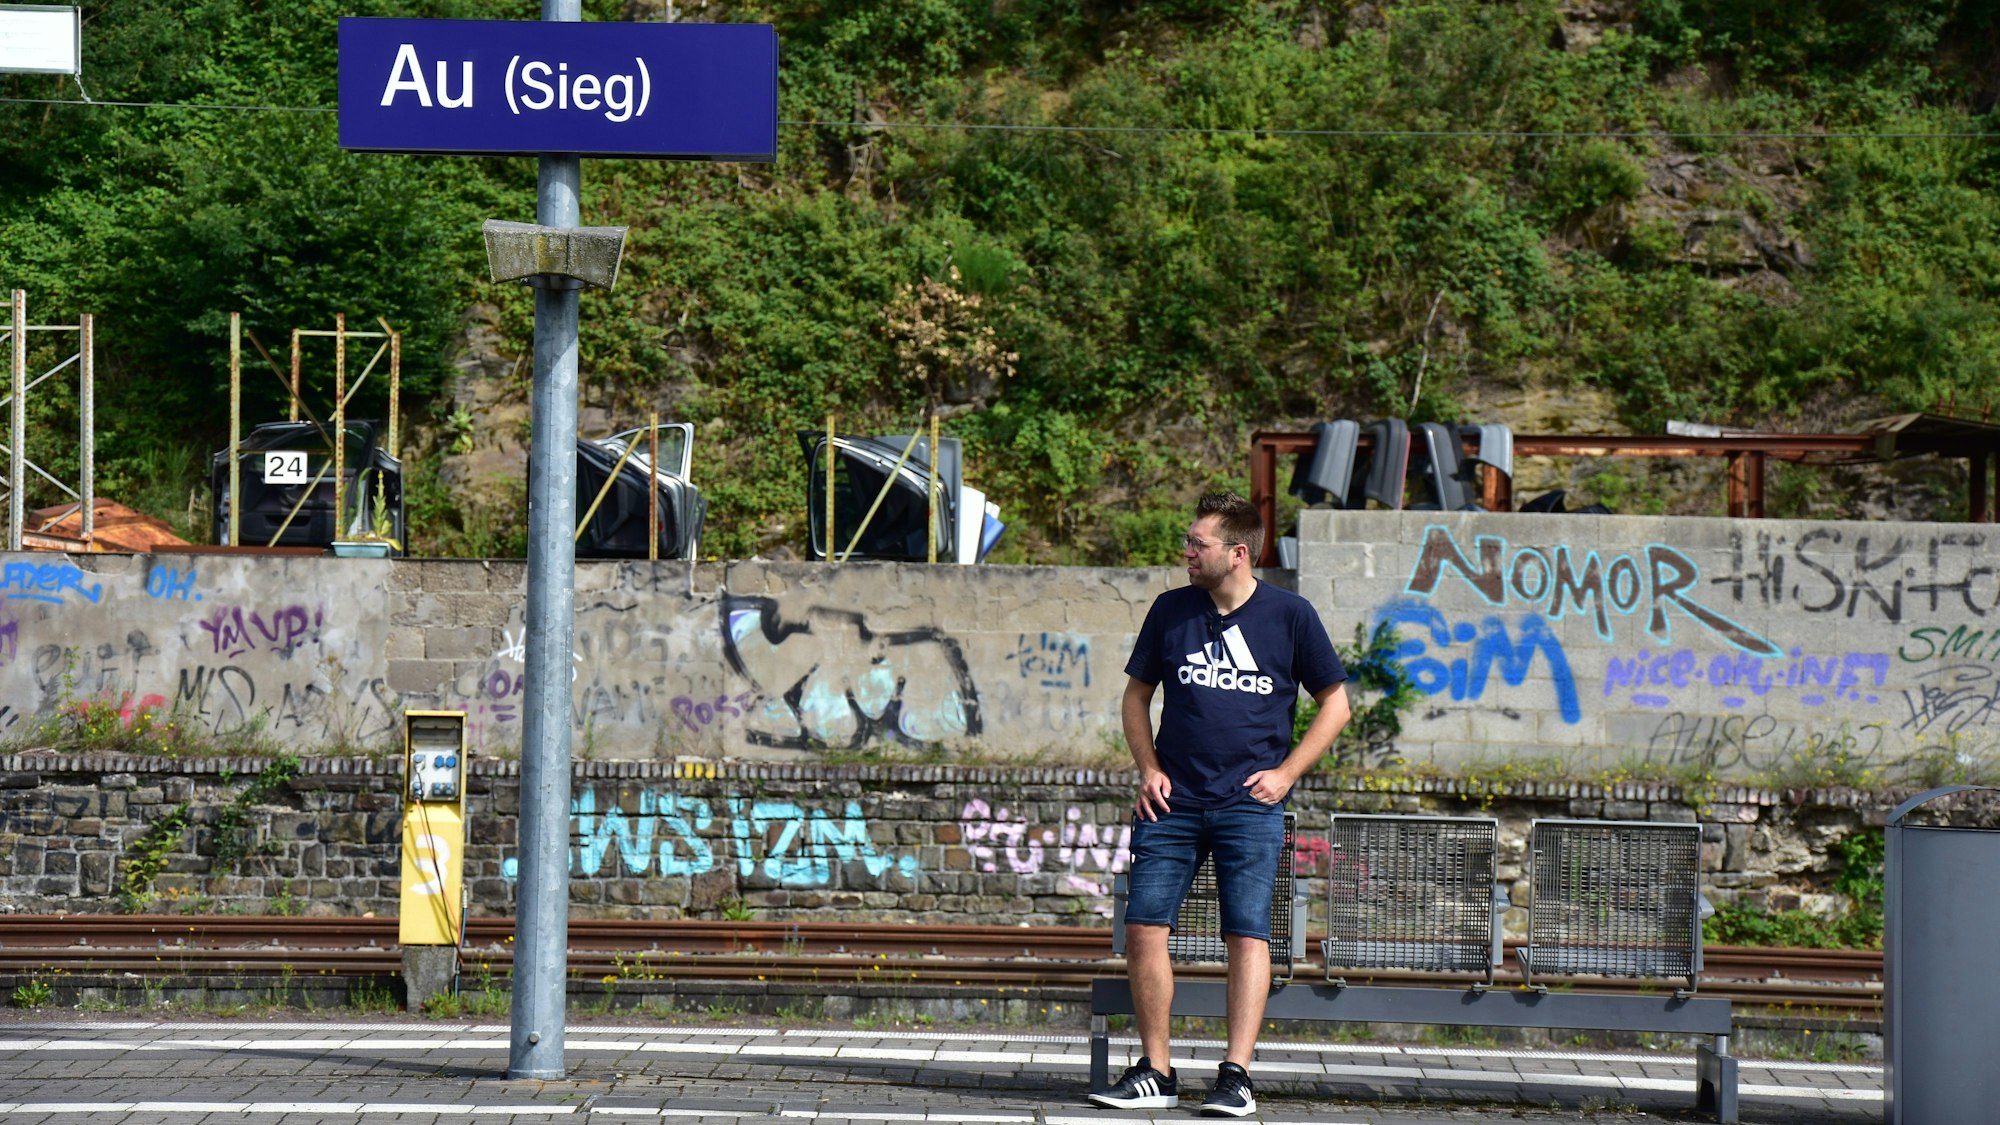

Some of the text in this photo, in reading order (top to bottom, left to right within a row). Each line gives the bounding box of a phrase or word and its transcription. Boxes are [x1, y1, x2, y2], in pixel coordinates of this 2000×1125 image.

[380, 43, 652, 123] Au (Sieg)
[268, 455, 303, 477] 24
[1177, 664, 1274, 695] adidas
